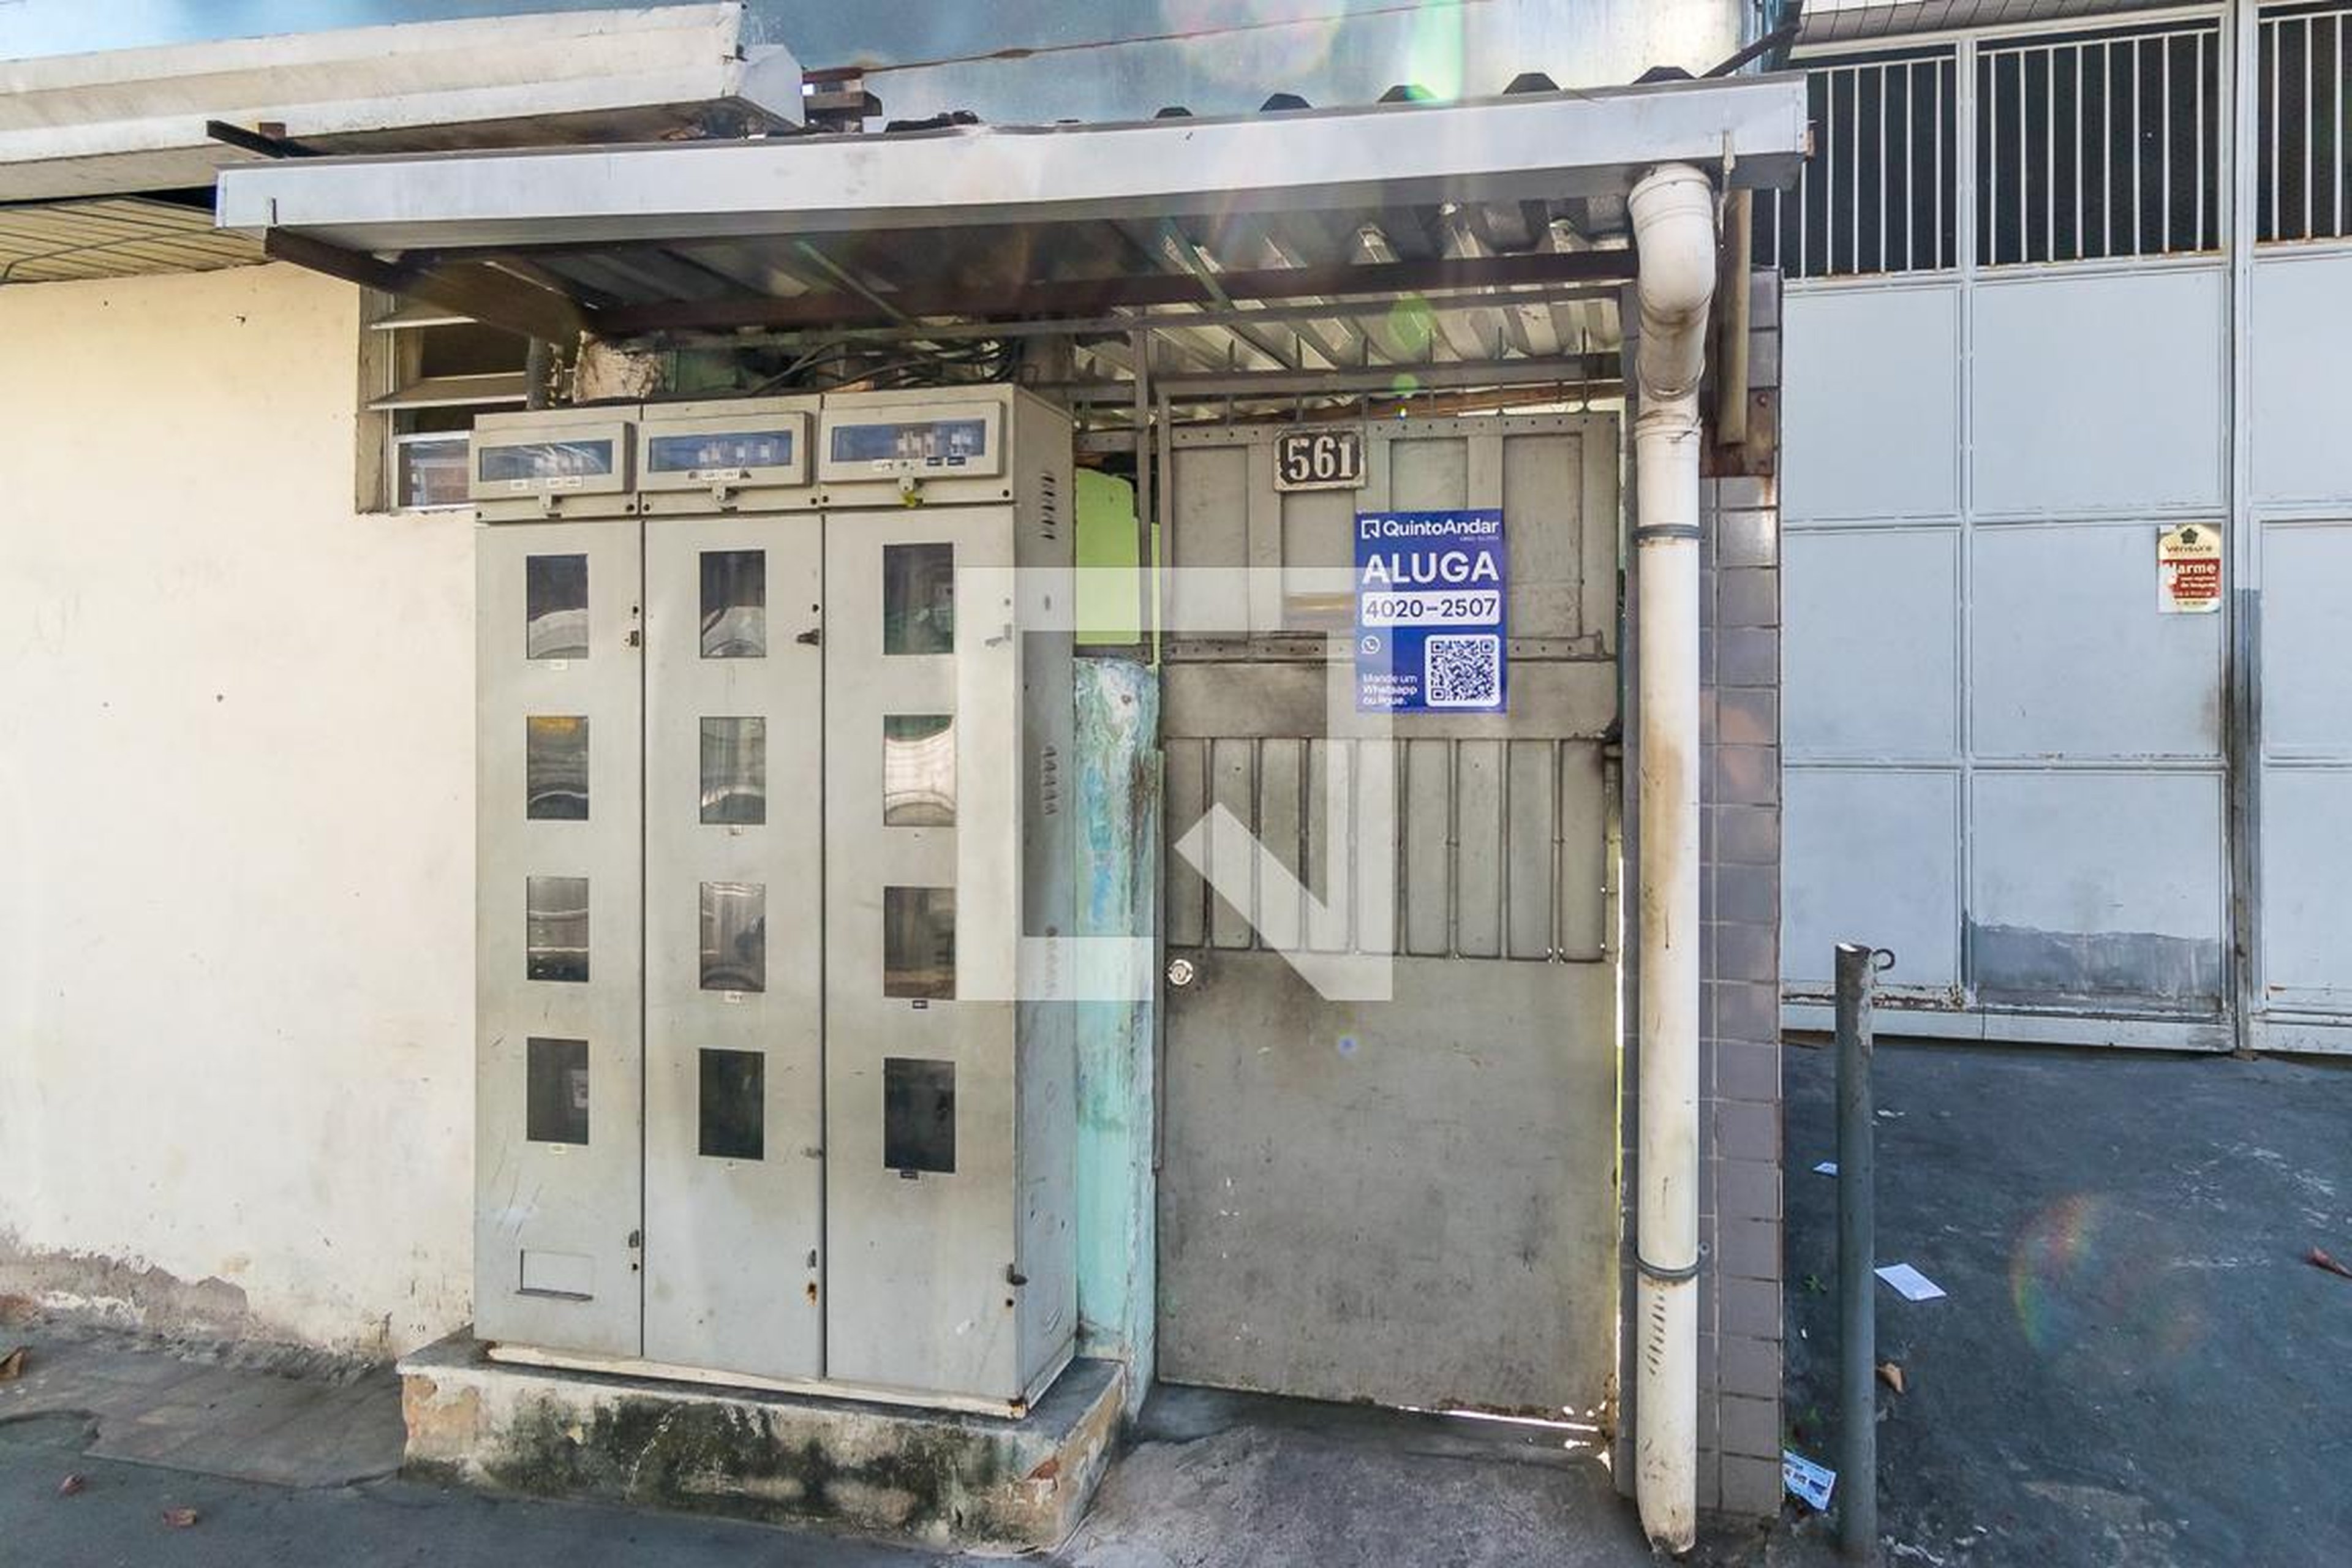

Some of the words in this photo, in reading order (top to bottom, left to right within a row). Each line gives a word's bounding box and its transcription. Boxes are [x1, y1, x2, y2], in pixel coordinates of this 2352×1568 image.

[1287, 435, 1352, 480] 561
[1382, 519, 1499, 537] QuintoAndar
[1362, 551, 1499, 584] ALUGA
[1365, 598, 1497, 618] 4020-2507
